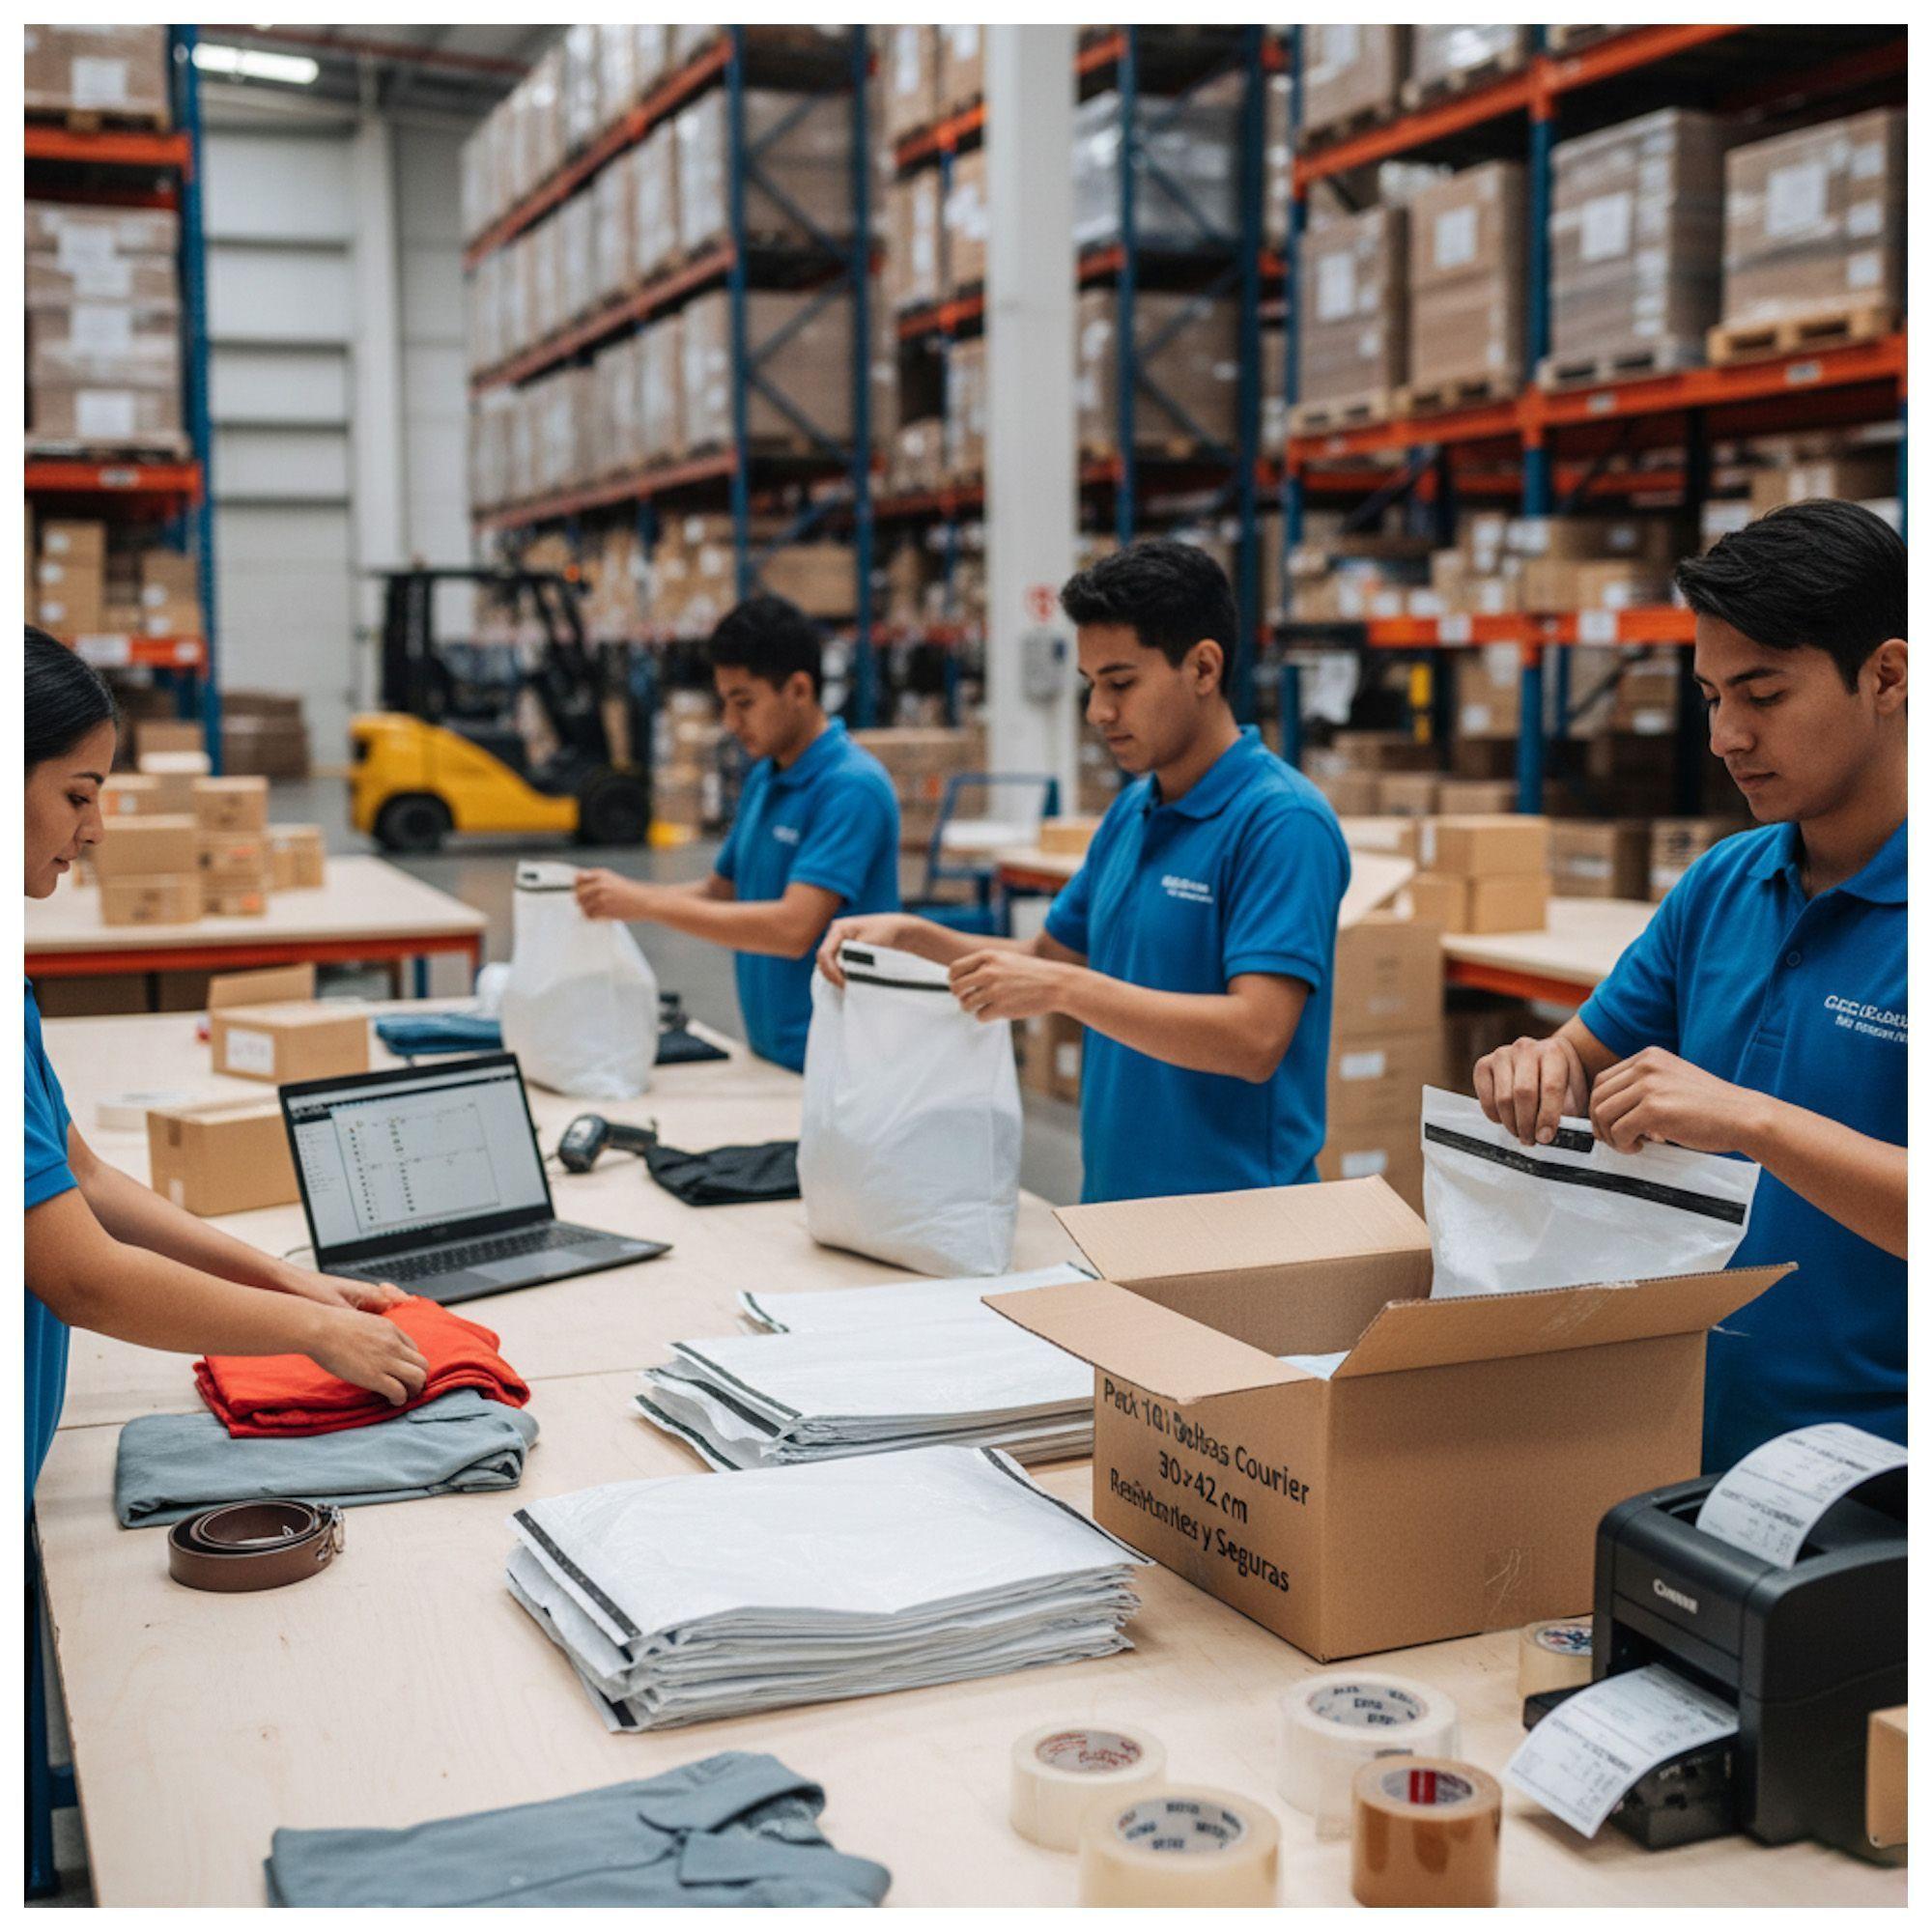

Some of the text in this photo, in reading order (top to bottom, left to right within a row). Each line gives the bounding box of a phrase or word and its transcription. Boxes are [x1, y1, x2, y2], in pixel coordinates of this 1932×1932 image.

[1236, 1444, 1311, 1506] Courier
[1222, 1492, 1248, 1524] cm
[1217, 1527, 1291, 1593] Seguras
